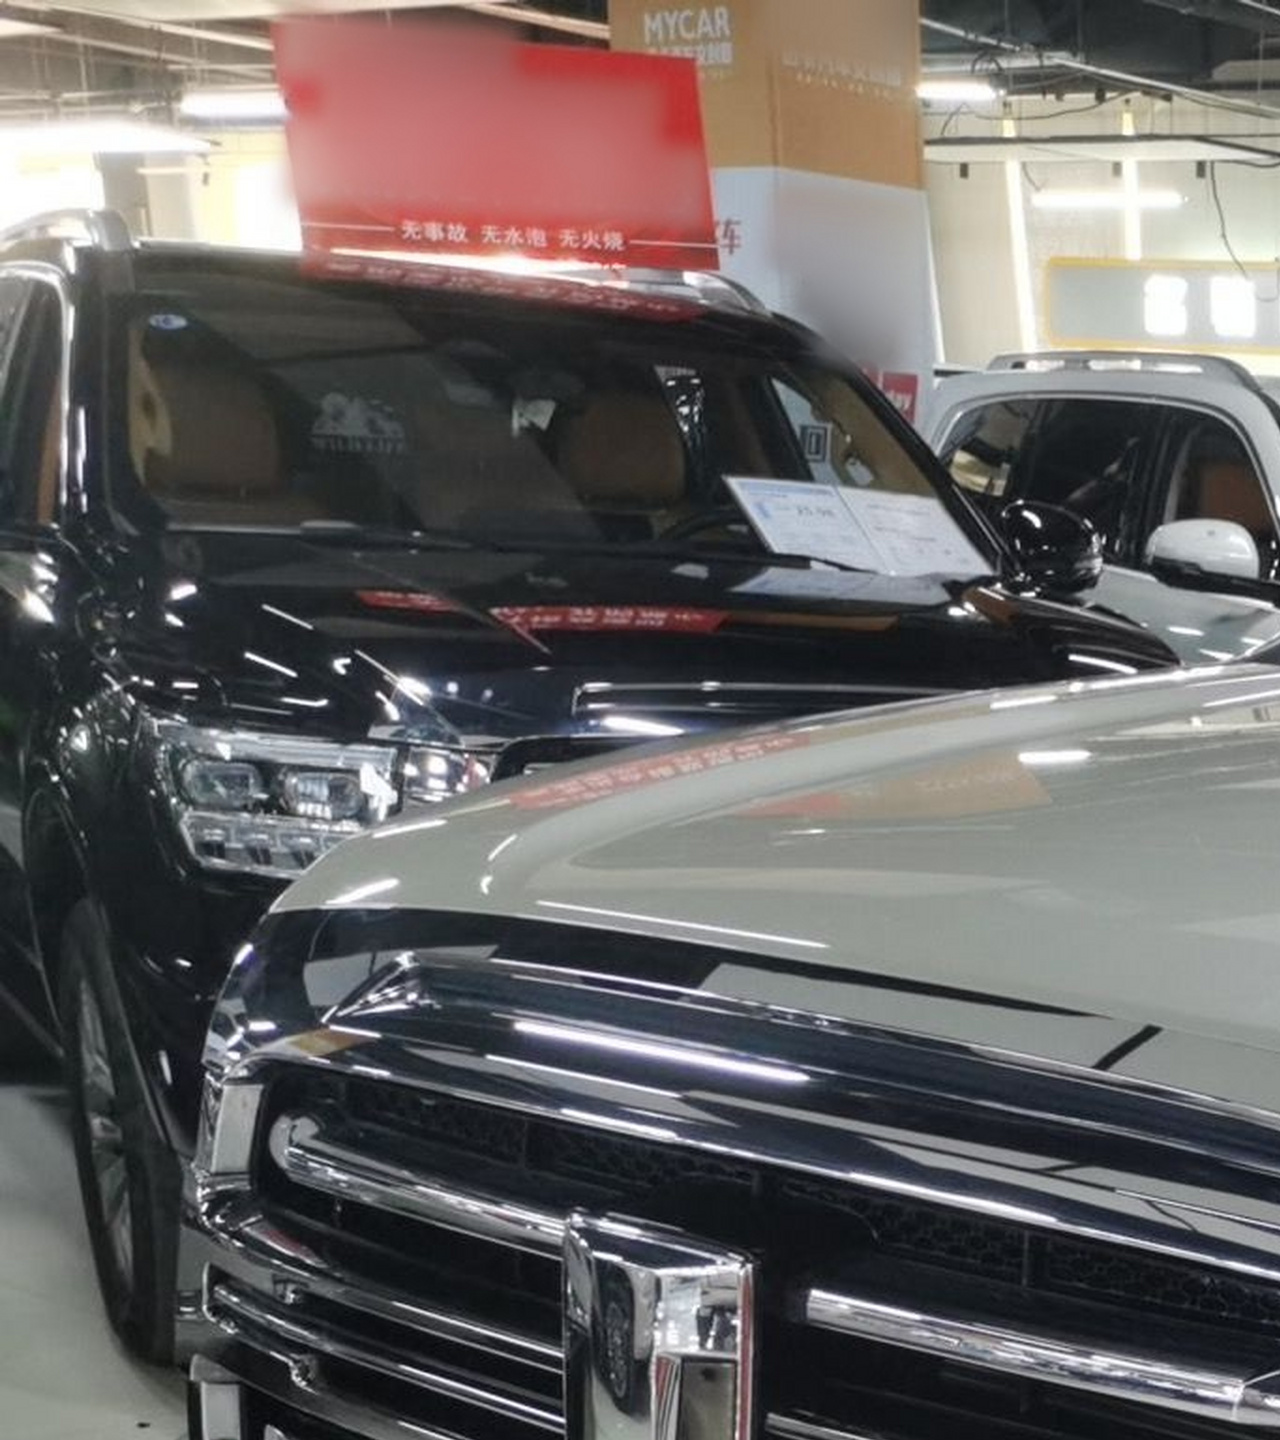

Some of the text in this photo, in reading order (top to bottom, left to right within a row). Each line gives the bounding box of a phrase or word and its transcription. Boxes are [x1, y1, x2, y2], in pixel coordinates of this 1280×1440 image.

[643, 6, 731, 45] MYCAR
[401, 219, 469, 243] 无事故
[559, 229, 625, 251] 无火烧
